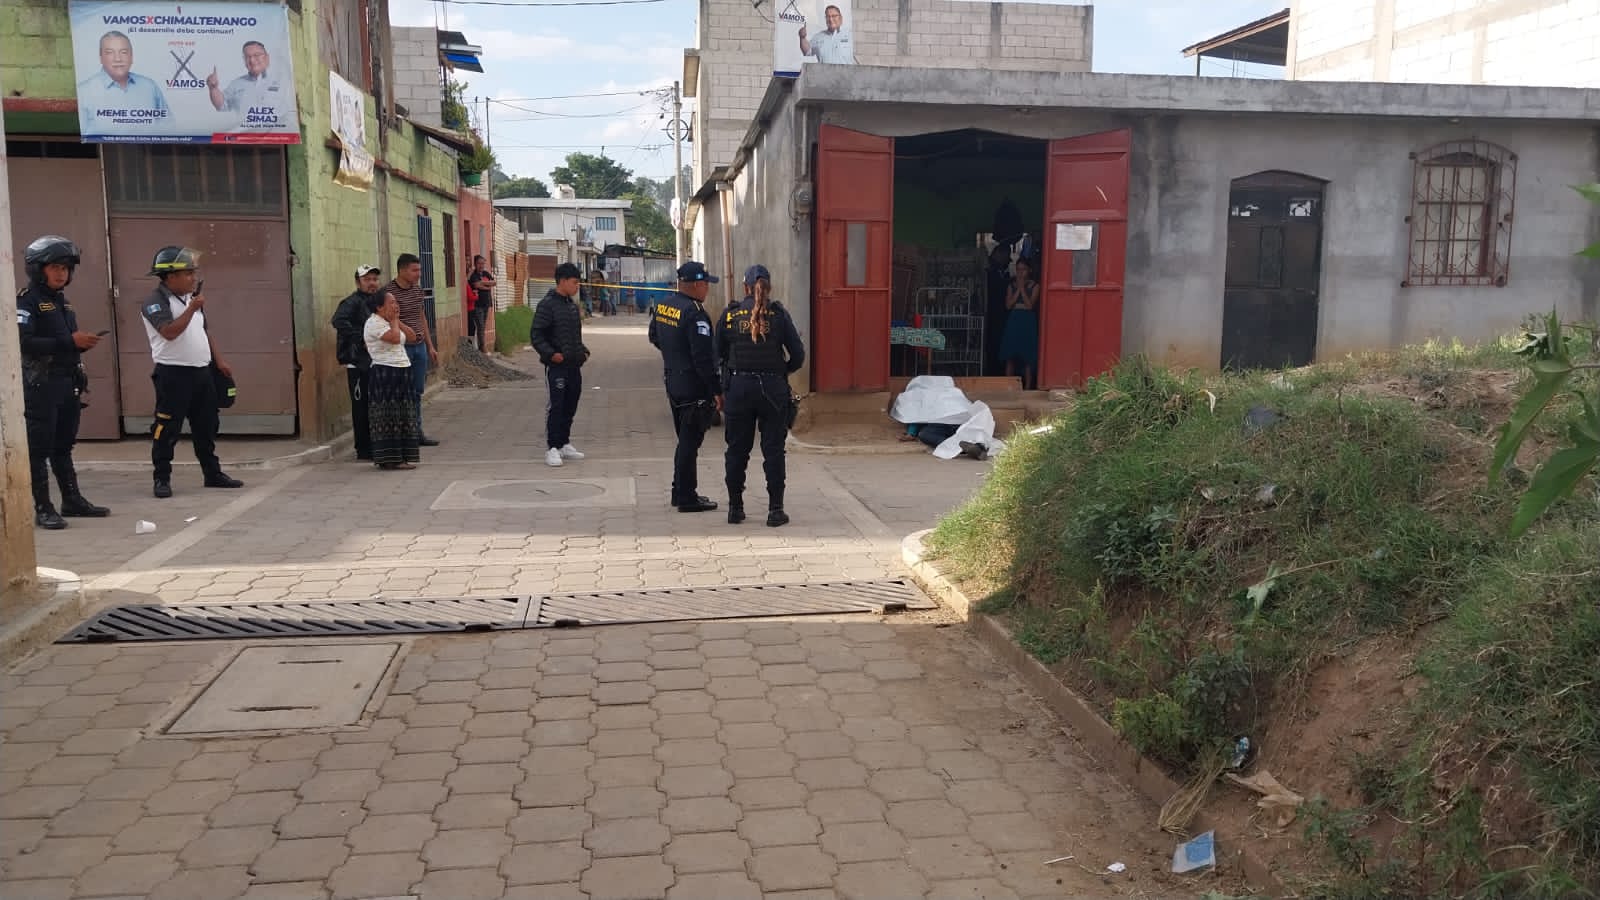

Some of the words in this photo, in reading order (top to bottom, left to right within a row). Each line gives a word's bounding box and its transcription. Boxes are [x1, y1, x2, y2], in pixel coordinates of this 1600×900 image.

[779, 12, 805, 22] VAMOS
[166, 79, 206, 88] VAMOS
[96, 109, 128, 117] MEME
[130, 109, 168, 118] CONDE
[247, 106, 275, 115] ALEX
[246, 115, 278, 123] SIMAJ
